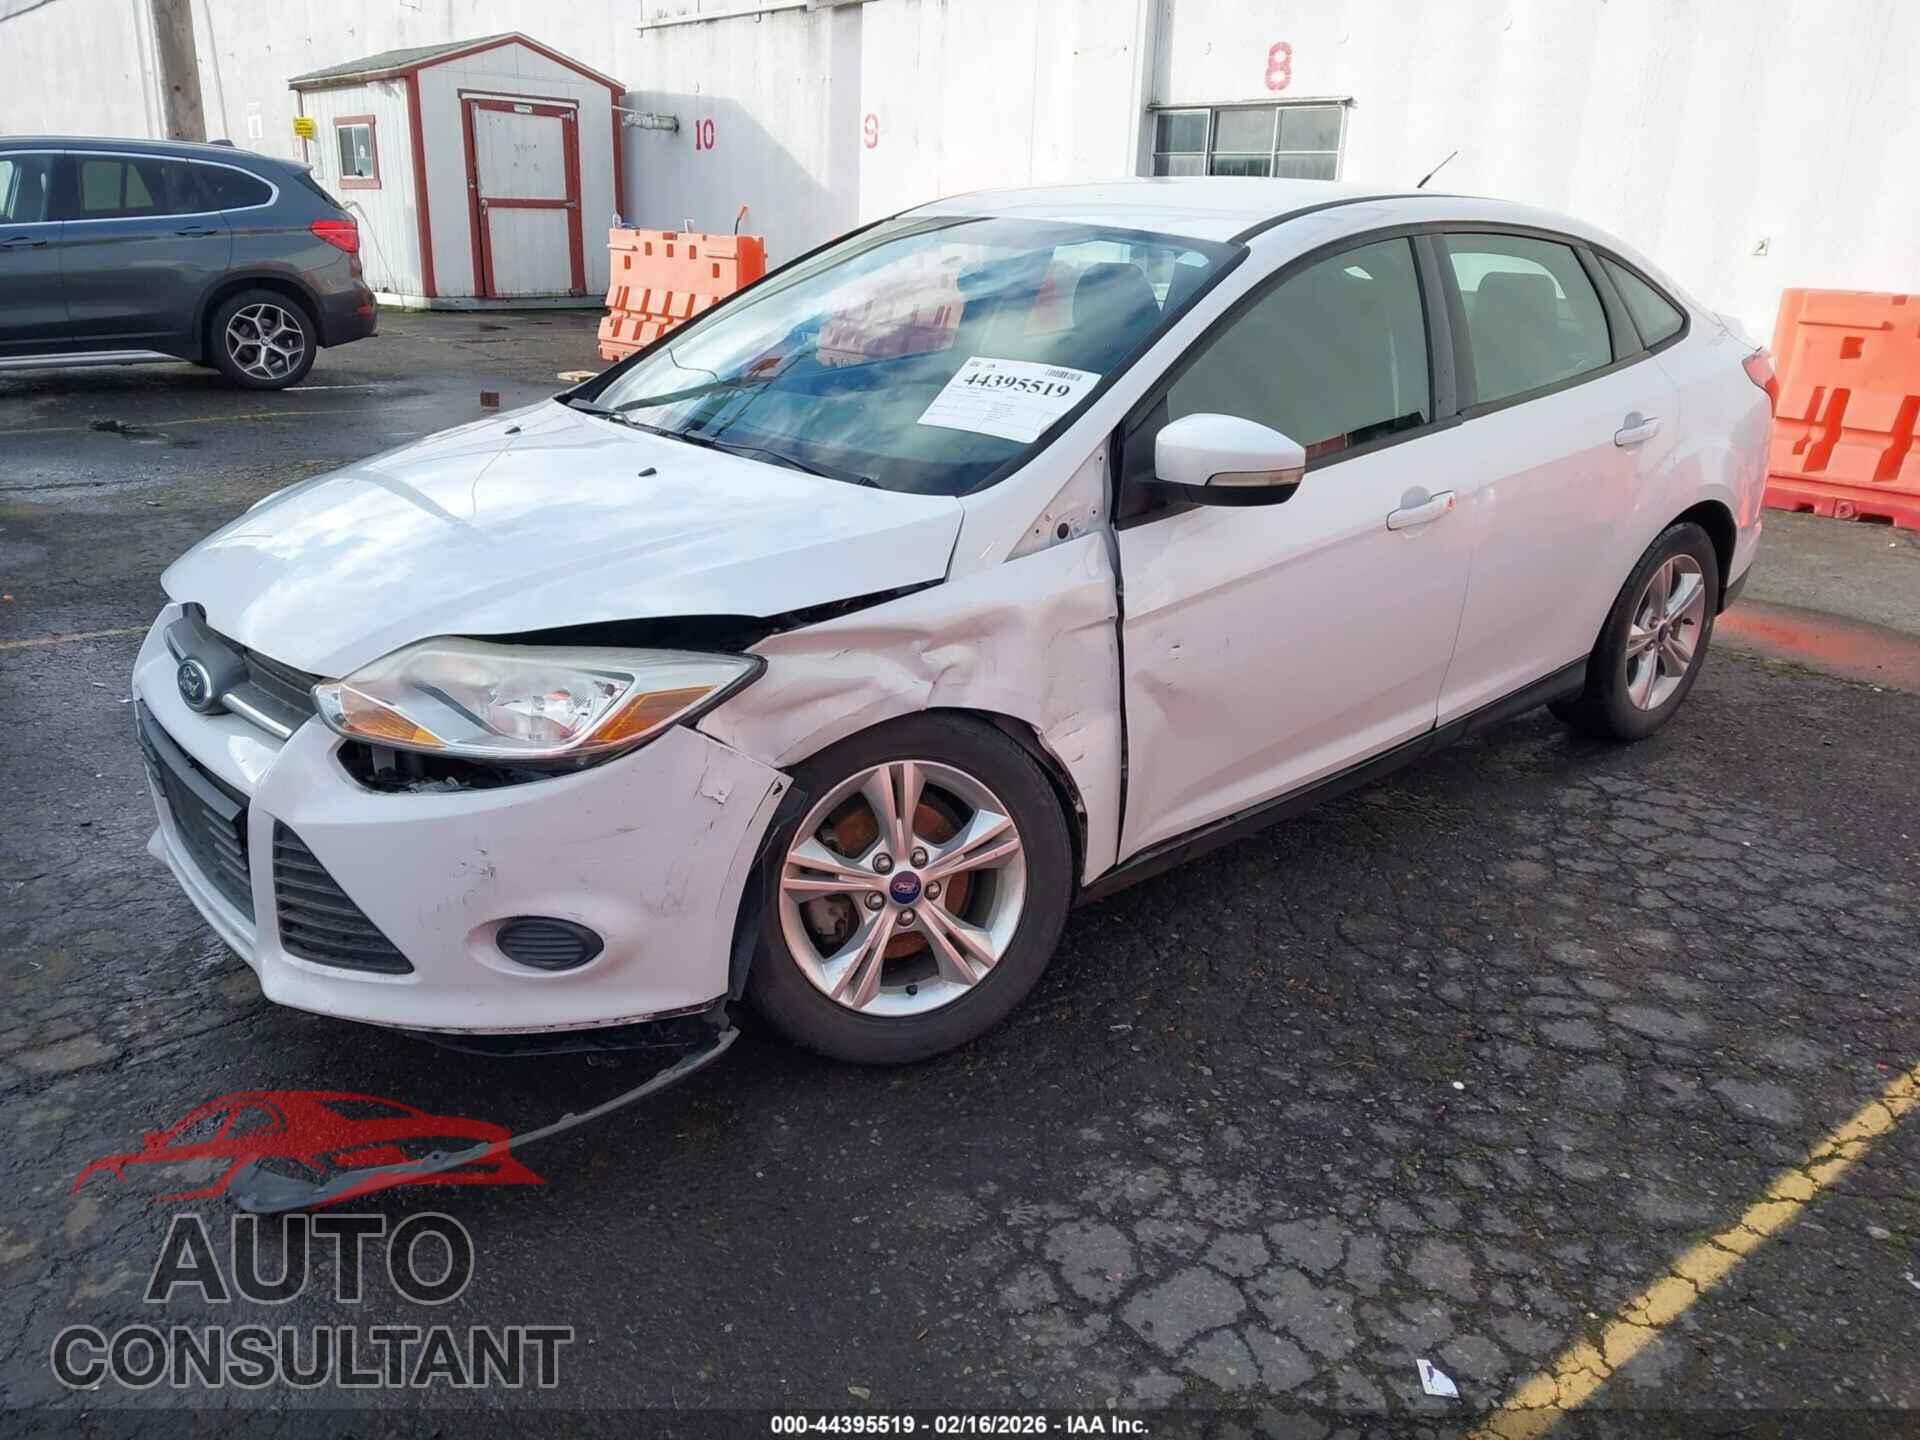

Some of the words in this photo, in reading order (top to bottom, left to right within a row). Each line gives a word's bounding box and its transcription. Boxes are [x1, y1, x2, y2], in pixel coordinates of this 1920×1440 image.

[1264, 41, 1292, 91] 8
[695, 118, 715, 151] 10
[864, 113, 879, 149] 9
[963, 372, 1071, 398] 44395519
